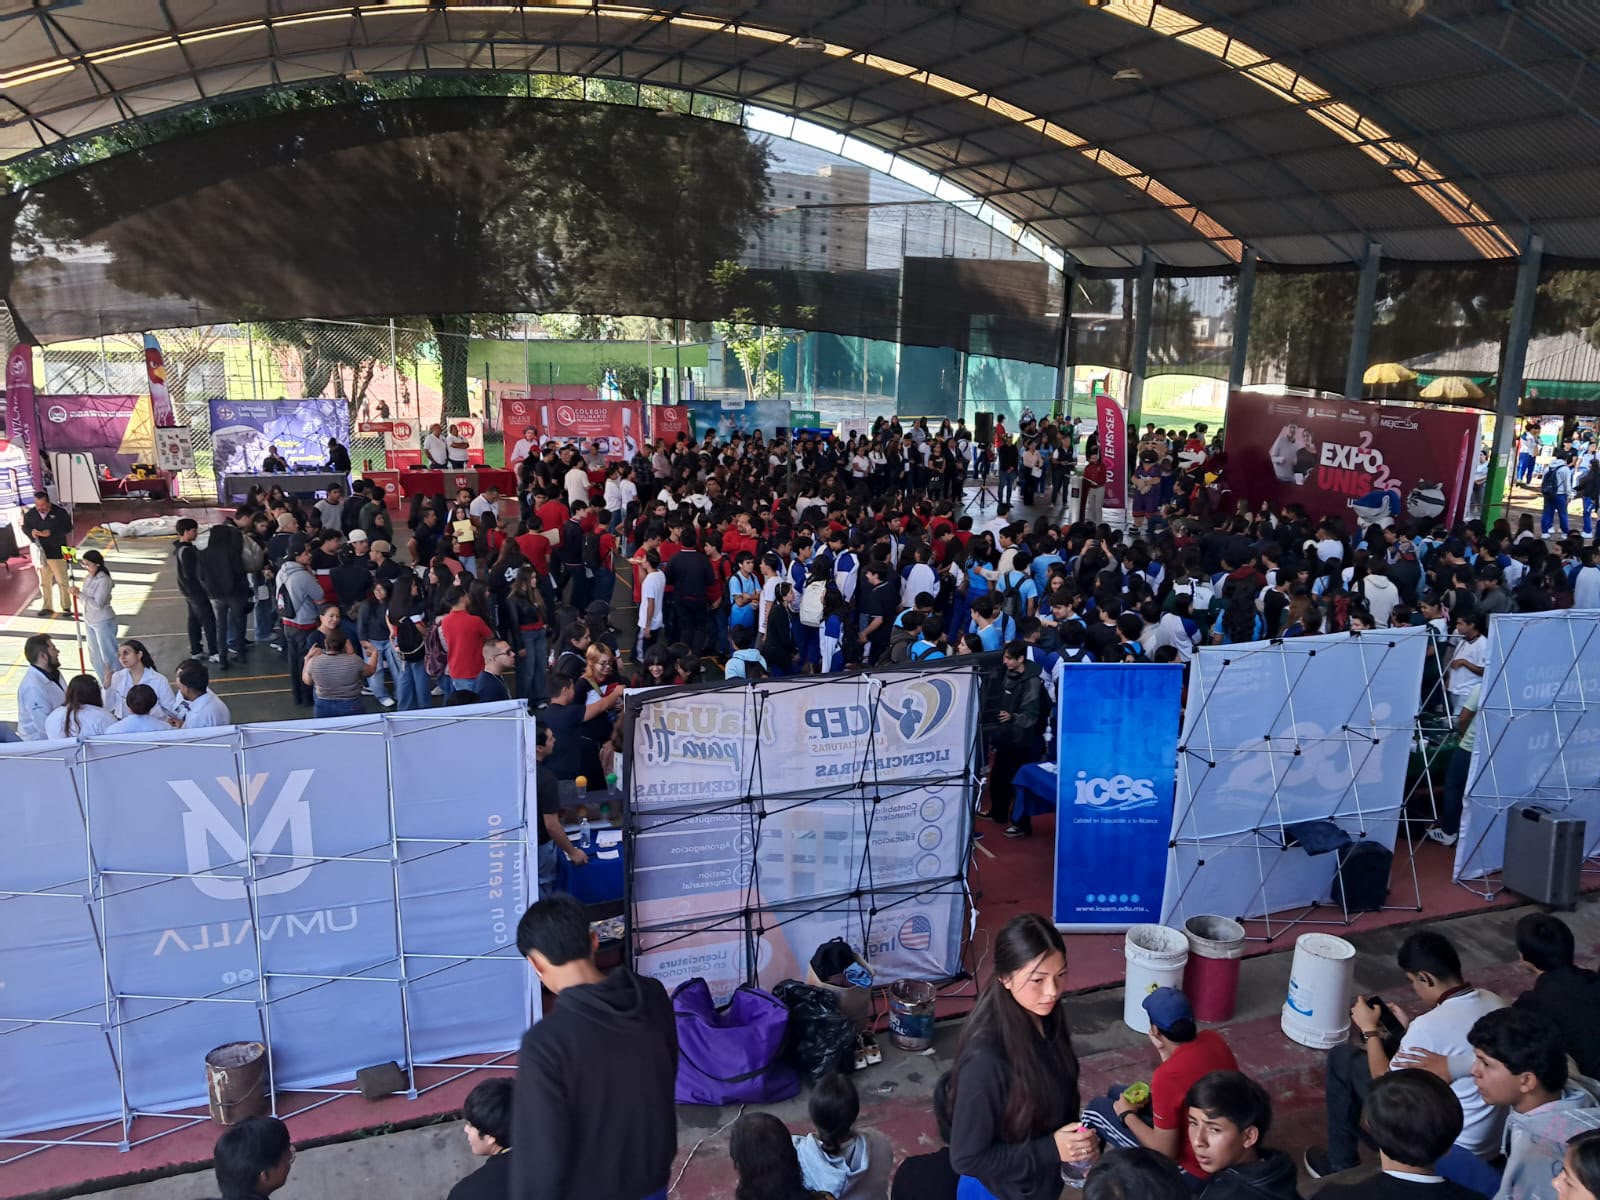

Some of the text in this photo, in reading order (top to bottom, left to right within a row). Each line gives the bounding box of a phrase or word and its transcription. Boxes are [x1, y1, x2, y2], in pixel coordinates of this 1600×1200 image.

[1320, 441, 1384, 474] EXPO
[1105, 470, 1114, 483] YO
[1074, 770, 1155, 805] ices
